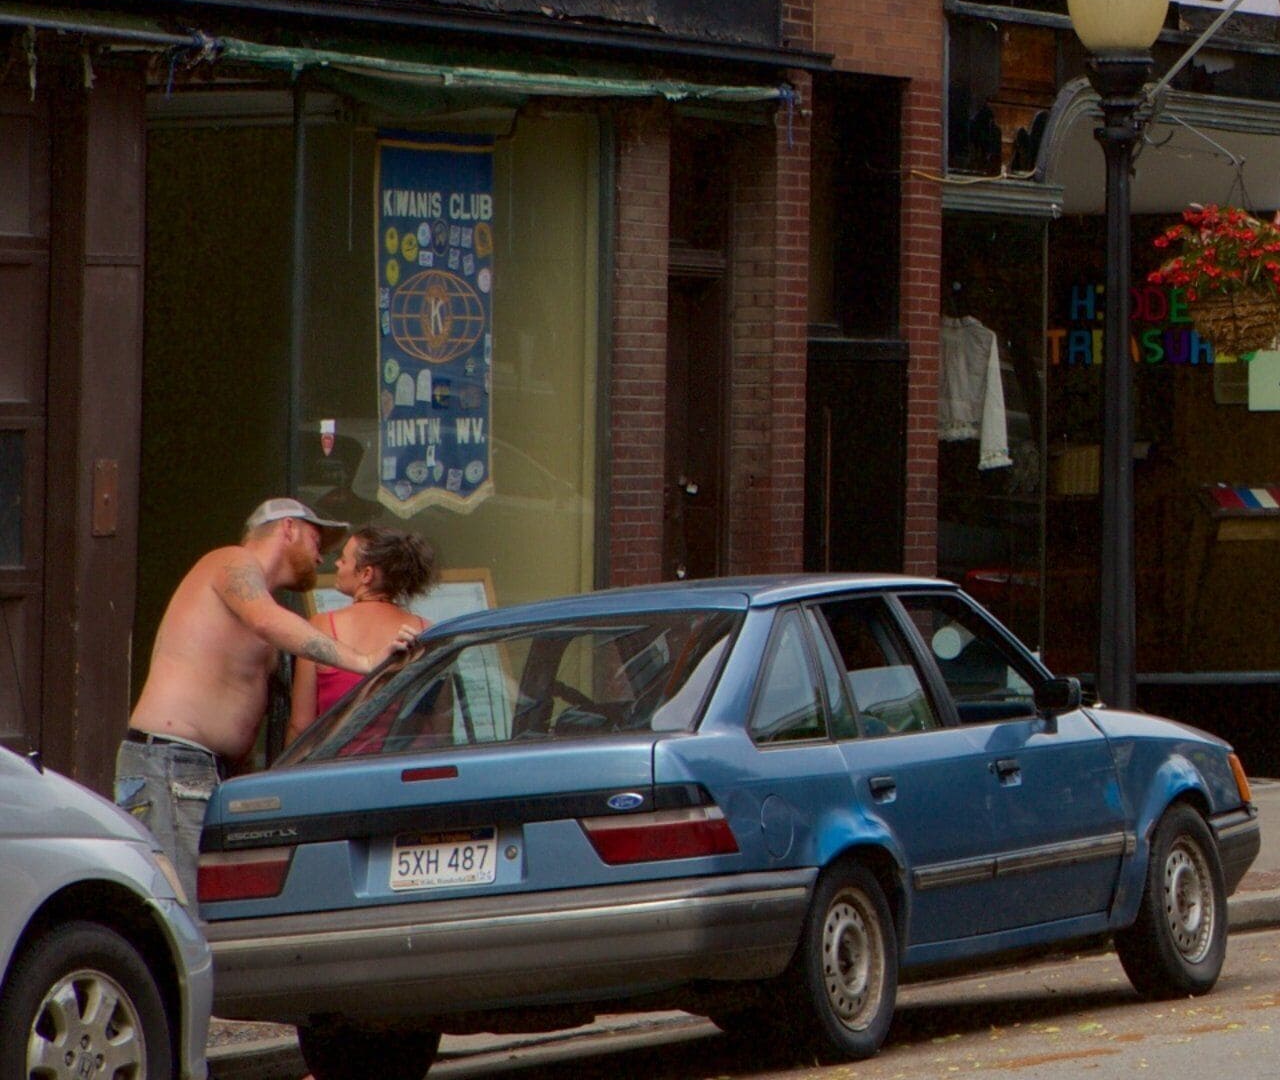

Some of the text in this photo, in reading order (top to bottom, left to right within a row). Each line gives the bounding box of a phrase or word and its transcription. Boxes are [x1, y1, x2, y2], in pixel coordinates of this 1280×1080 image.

[383, 189, 493, 220] KIWANIS CLUB
[279, 827, 298, 837] LX
[397, 844, 489, 877] 5XH 487
